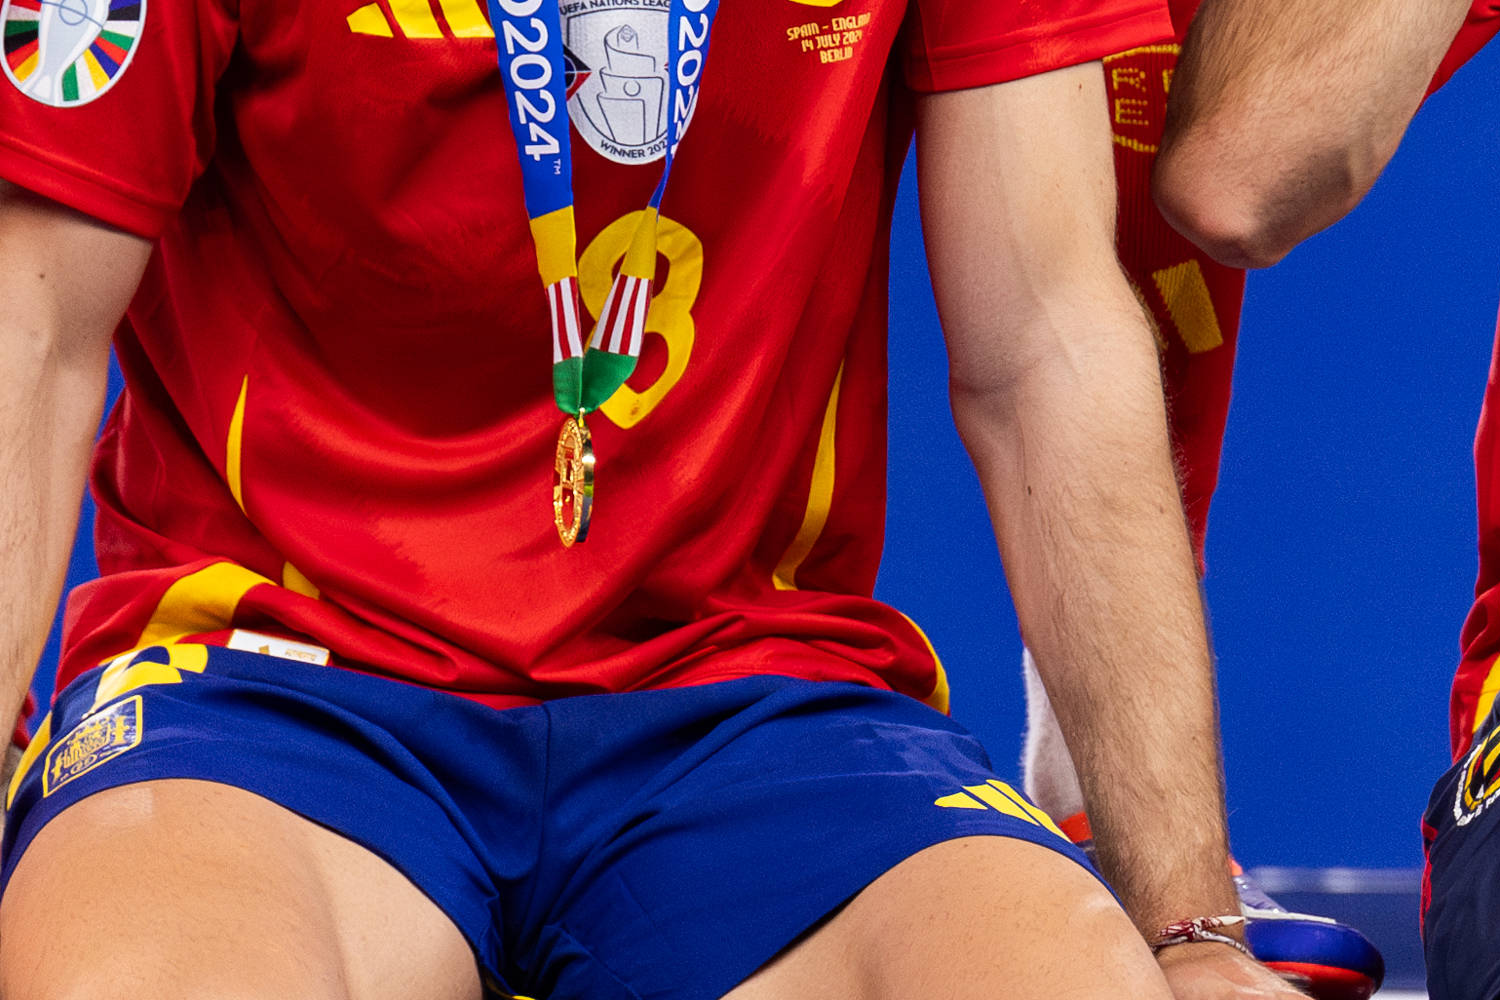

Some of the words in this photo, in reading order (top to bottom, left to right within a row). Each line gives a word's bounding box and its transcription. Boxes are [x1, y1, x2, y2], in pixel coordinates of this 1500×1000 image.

[559, 2, 587, 15] UEFA
[786, 22, 820, 41] SPAIN
[801, 39, 814, 53] 14
[815, 33, 841, 49] JULY
[820, 46, 853, 64] BERLIN
[600, 138, 646, 159] WINNER
[647, 136, 668, 156] 202
